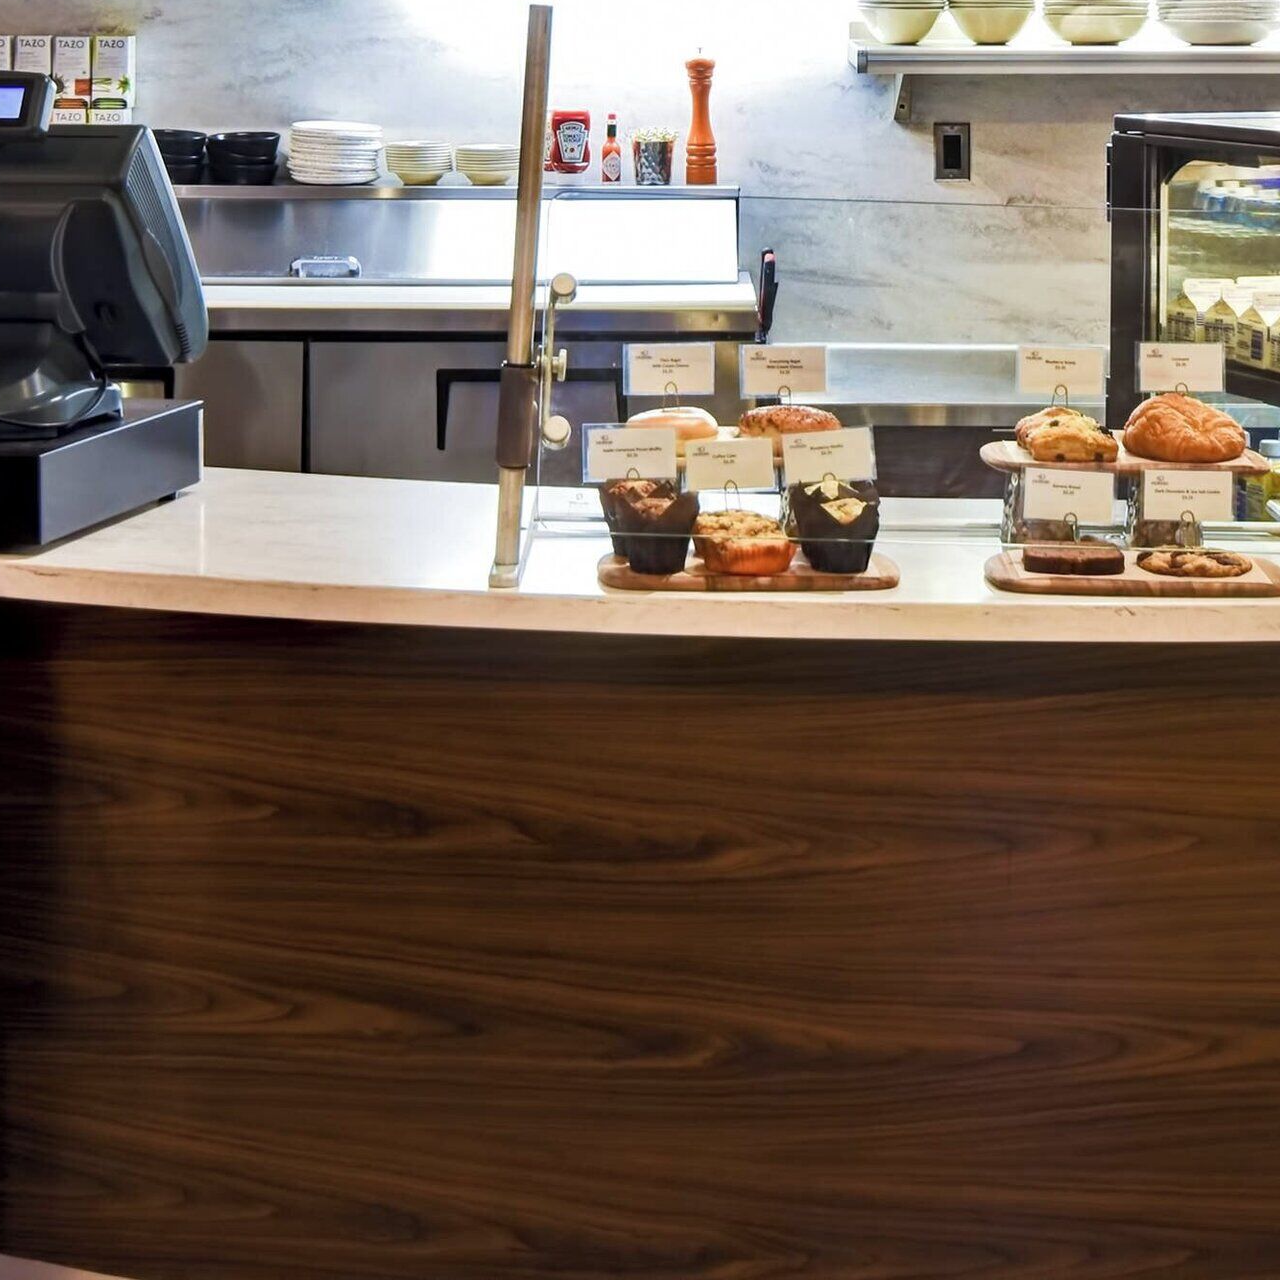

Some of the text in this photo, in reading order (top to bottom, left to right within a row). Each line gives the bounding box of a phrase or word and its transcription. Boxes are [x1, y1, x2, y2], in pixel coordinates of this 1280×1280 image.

[20, 39, 46, 48] TAZO
[58, 39, 85, 49] TAZO
[99, 39, 125, 49] TAZO
